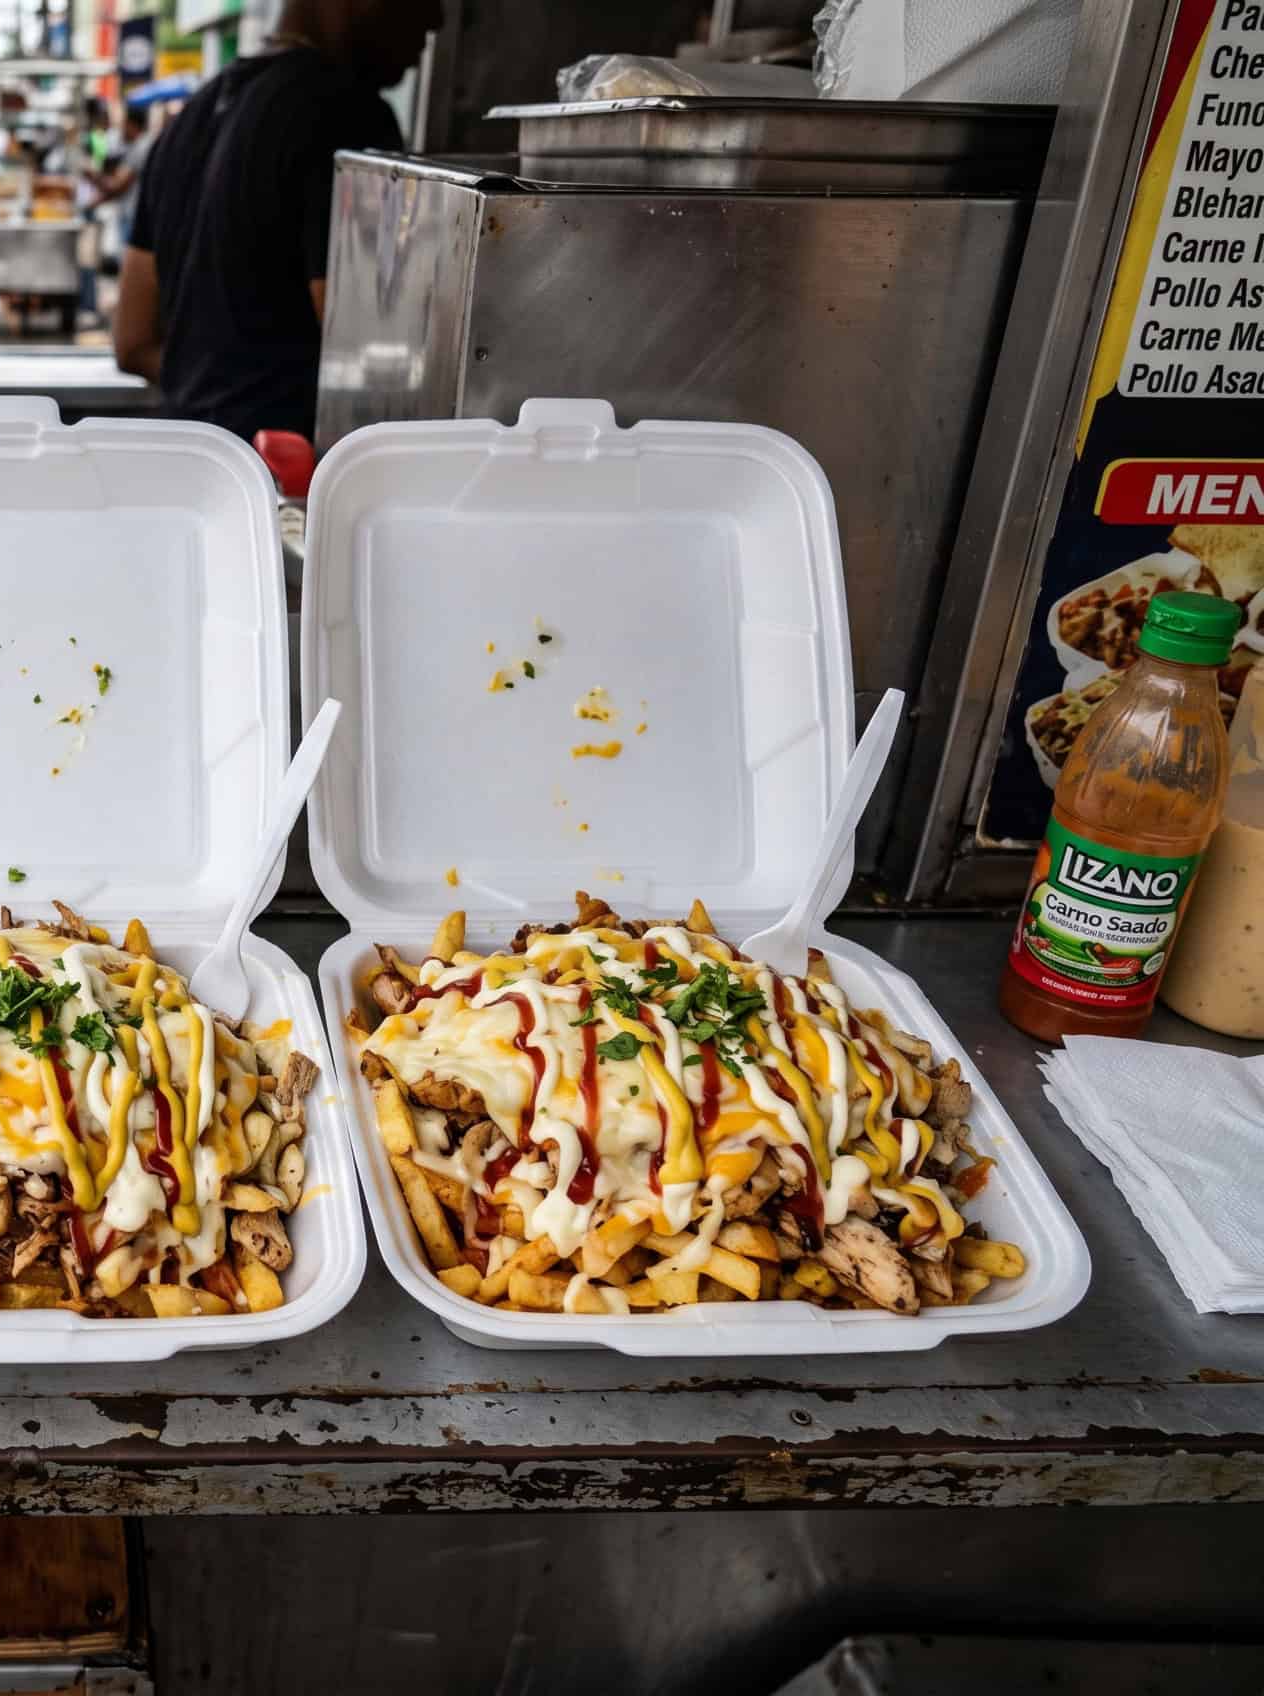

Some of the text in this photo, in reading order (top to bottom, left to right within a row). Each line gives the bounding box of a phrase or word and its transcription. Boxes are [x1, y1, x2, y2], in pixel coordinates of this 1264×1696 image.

[1221, 0, 1264, 31] Pa
[1211, 45, 1264, 79] Che
[1185, 140, 1264, 181] Mayo
[1162, 232, 1245, 263] Carne
[1149, 277, 1264, 308] Pollo As
[1140, 320, 1221, 351] Carne
[1127, 363, 1198, 393] Pollo
[1146, 474, 1264, 515] MEN
[1058, 844, 1179, 906] LIZANO
[1046, 893, 1102, 928] Carno
[1107, 916, 1168, 935] Saado
